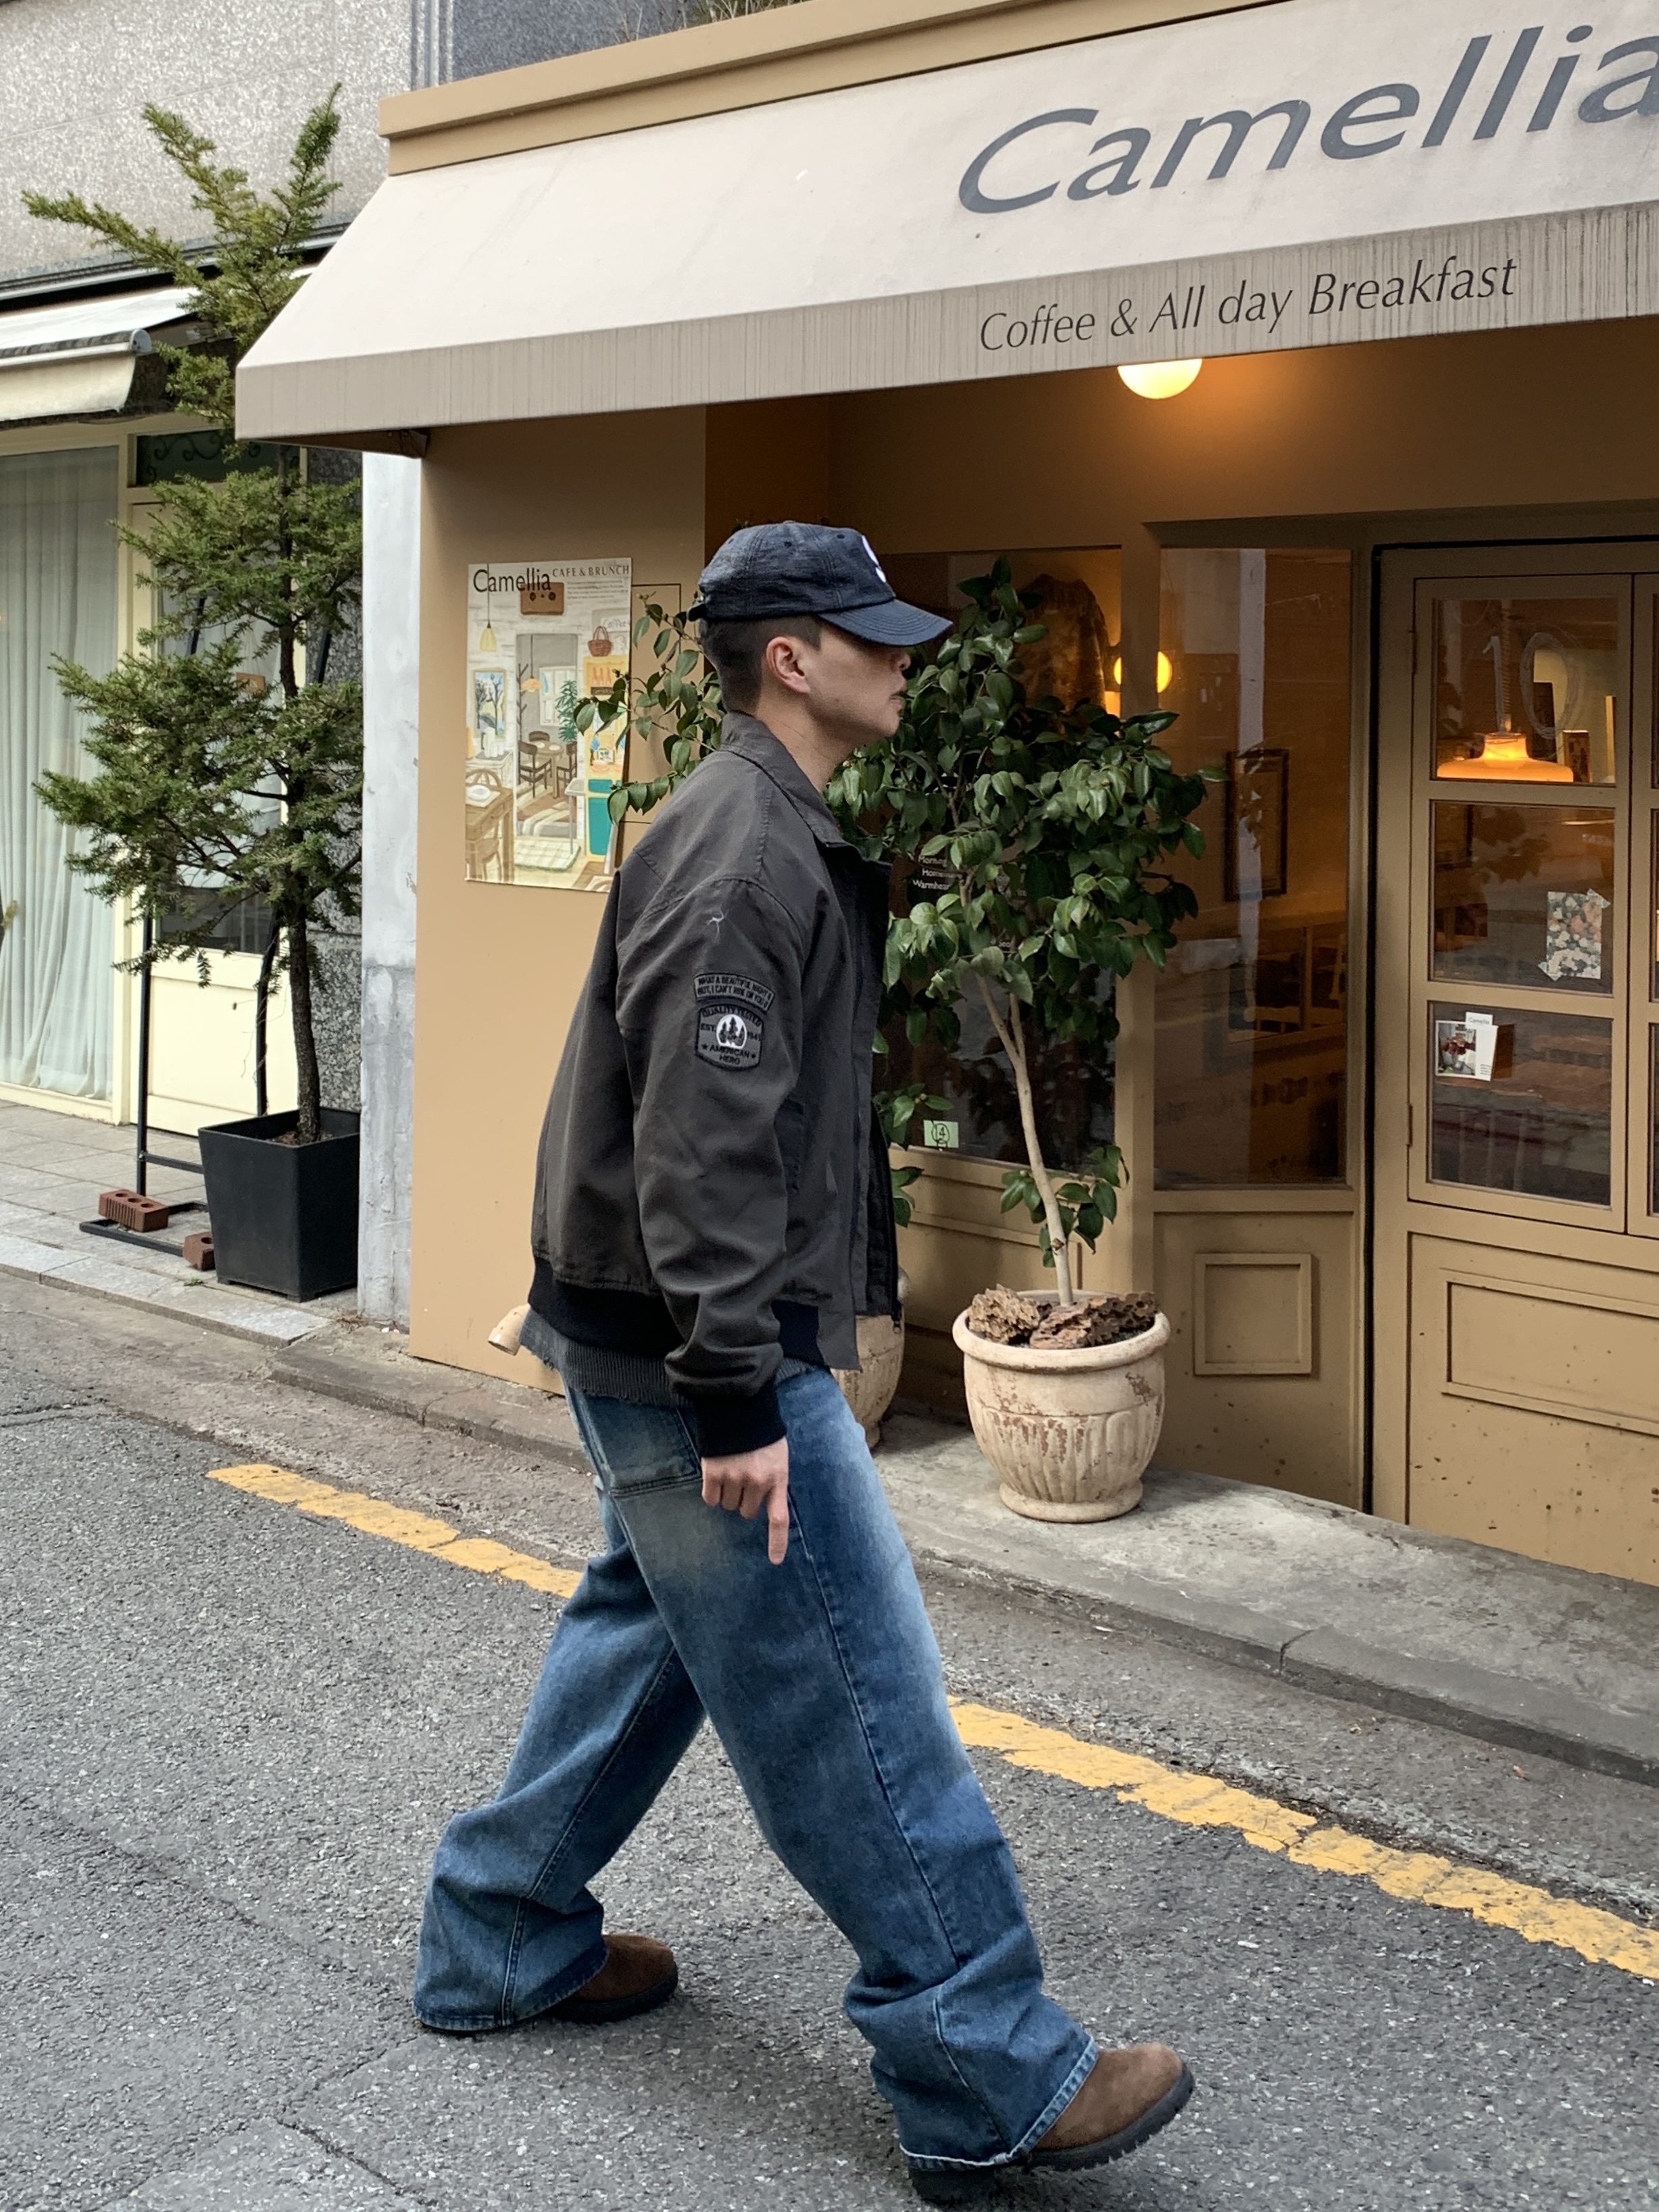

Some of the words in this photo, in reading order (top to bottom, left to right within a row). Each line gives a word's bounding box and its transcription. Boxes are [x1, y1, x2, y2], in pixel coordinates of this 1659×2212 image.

[958, 25, 1659, 215] Camellia
[981, 303, 1095, 351] Coffee
[1110, 298, 1138, 337] &
[1149, 285, 1205, 333] All
[1218, 280, 1293, 333] day
[1309, 255, 1517, 315] Breakfast
[473, 568, 551, 593] Camellia
[552, 568, 576, 577] CAFE
[589, 565, 629, 576] BRUNCH
